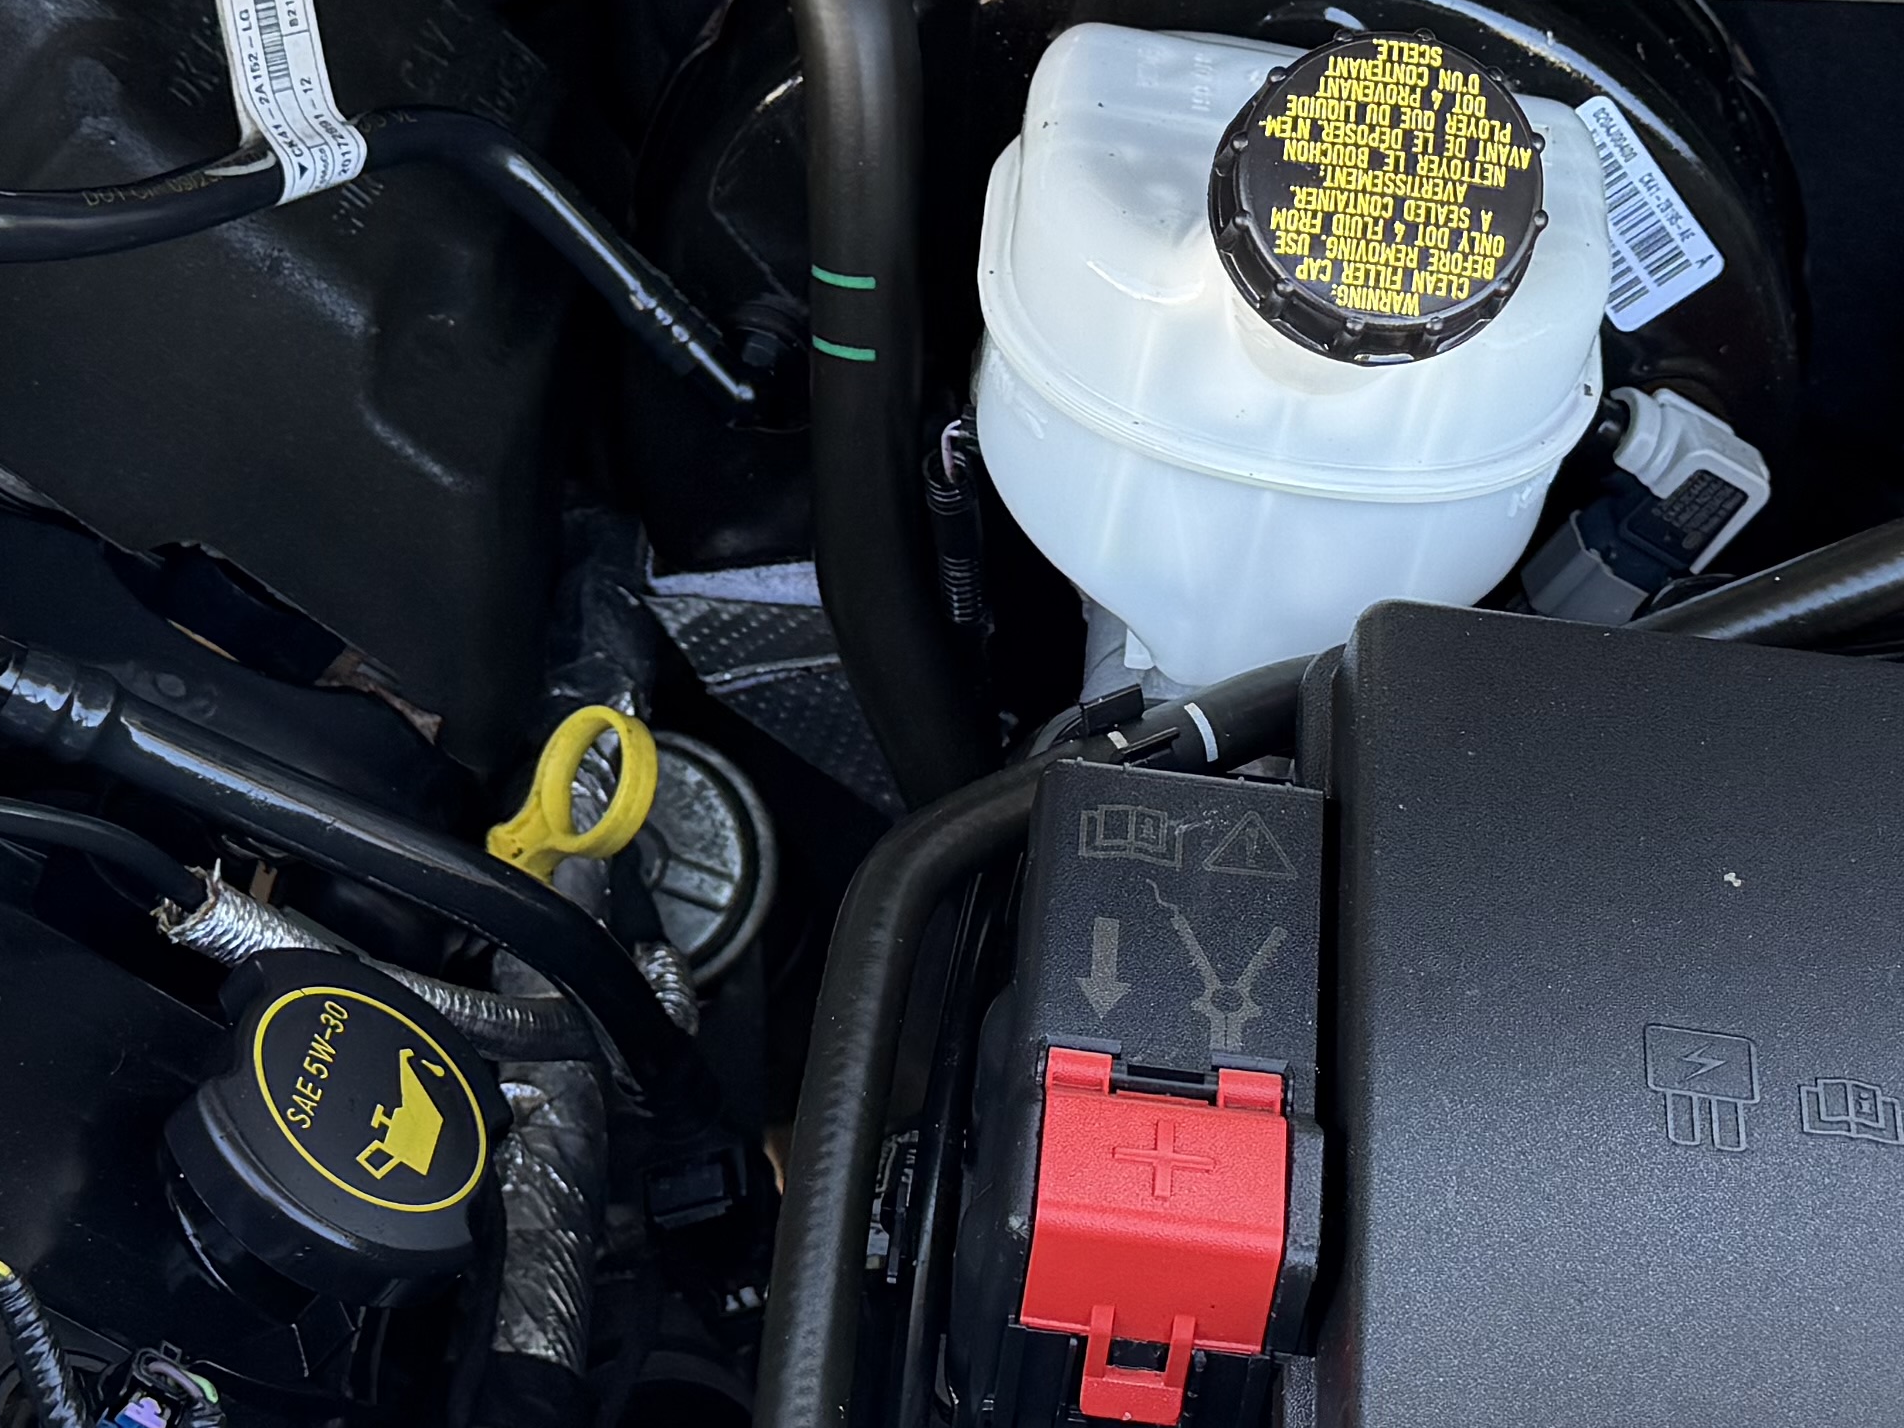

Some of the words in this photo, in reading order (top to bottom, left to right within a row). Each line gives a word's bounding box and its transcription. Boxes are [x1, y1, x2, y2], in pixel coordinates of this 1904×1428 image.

[1325, 58, 1429, 87] CONTENANT
[1439, 70, 1480, 94] D'UN
[1315, 75, 1421, 110] PROVENANT
[1431, 91, 1443, 110] 4
[1453, 92, 1486, 117] DOT
[1286, 95, 1357, 124] LIQUIDE
[1365, 103, 1391, 126] DU
[1399, 106, 1435, 132] QUE
[1446, 113, 1511, 142] PLOYER
[1284, 135, 1369, 170] BOUCHON
[1413, 131, 1434, 154] LE
[1444, 135, 1466, 158] DE
[1477, 139, 1532, 169] AVANT
[1383, 149, 1405, 173] LE
[1417, 154, 1506, 187] NETTOYER
[1318, 164, 1469, 204] AVERTISSEMENT:
[1271, 208, 1323, 234] FROM
[1332, 213, 1384, 241] FLUID
[1404, 199, 1470, 229] SEALED
[1480, 209, 1494, 232] A
[1276, 229, 1310, 256] USE
[1394, 222, 1406, 242] 4
[1415, 224, 1450, 249] DOT
[1459, 231, 1505, 256] ONLY
[1296, 258, 1332, 282] CAP
[1342, 260, 1403, 292] FILLER
[1428, 247, 1497, 280] BEFORE
[1335, 282, 1420, 315] WARNING:
[1412, 270, 1472, 299] CLEAN
[302, 999, 352, 1081] 5W-30
[285, 1076, 325, 1130] SAE
